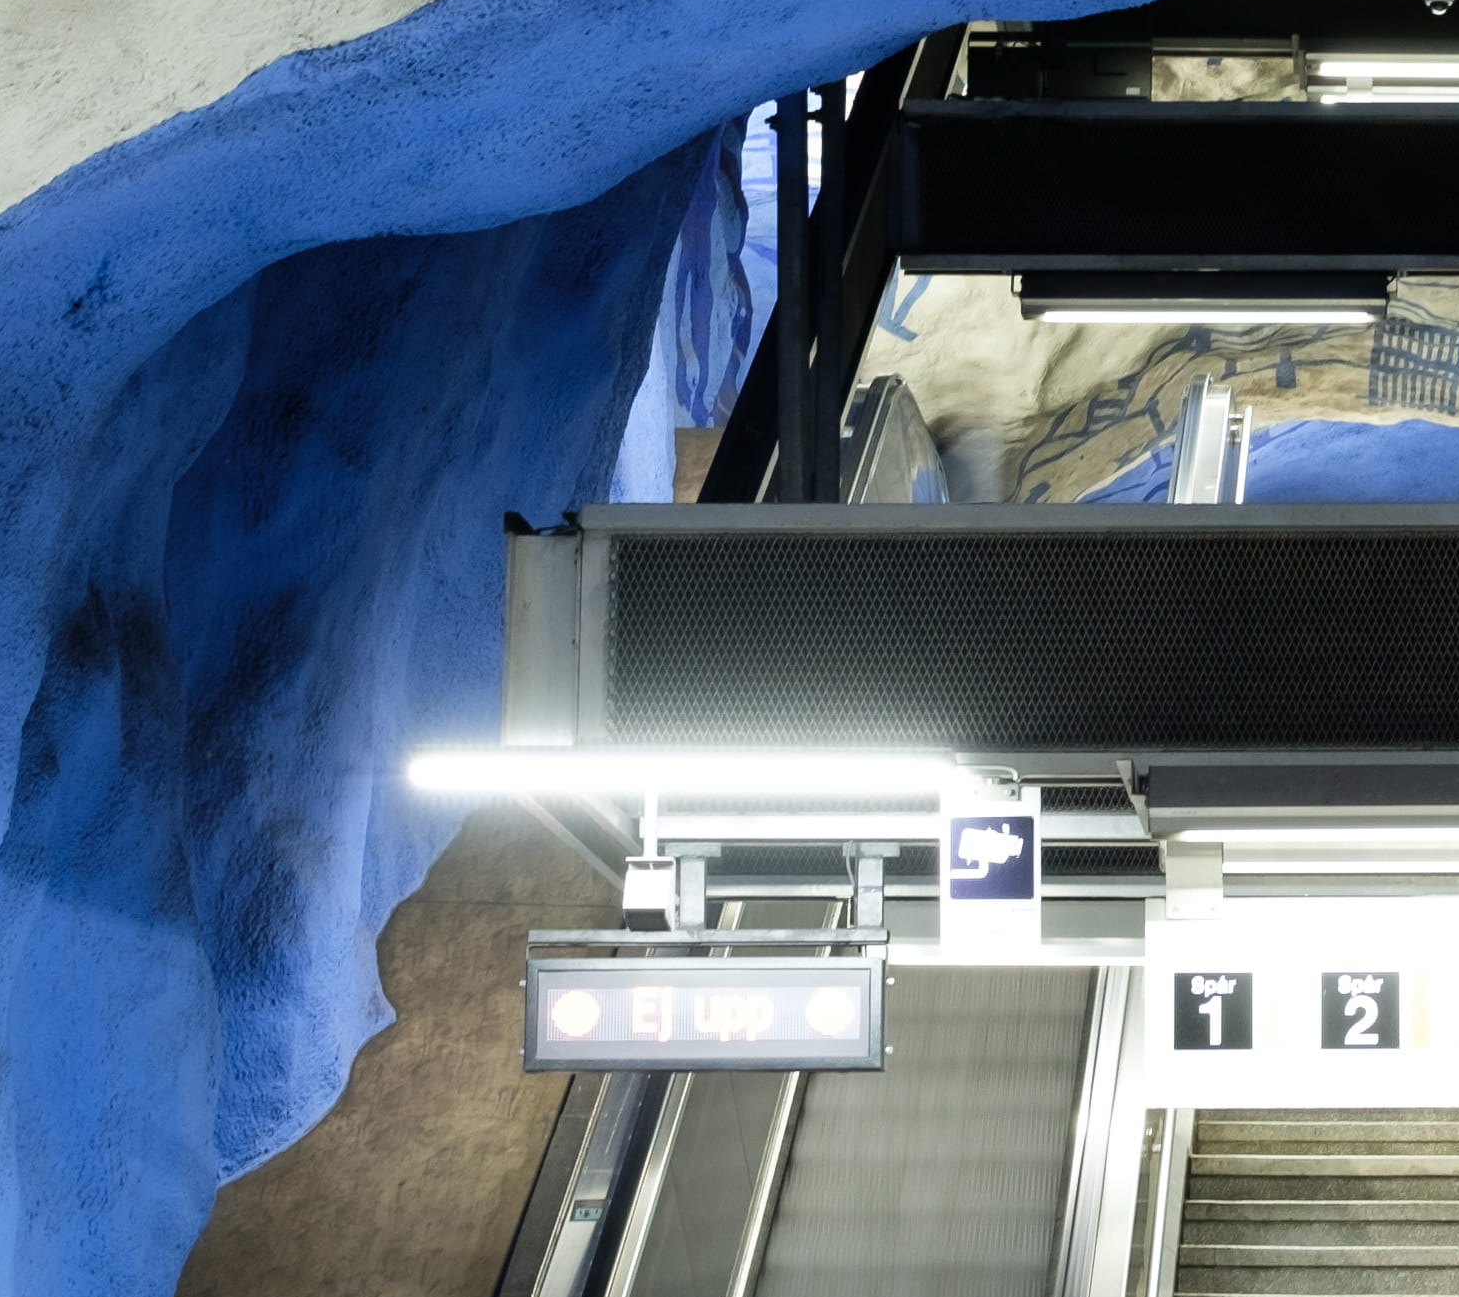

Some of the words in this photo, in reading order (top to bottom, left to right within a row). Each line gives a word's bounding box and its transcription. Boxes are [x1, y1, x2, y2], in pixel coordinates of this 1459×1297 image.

[1190, 975, 1237, 998] Spår
[1337, 974, 1384, 997] Spår
[631, 986, 674, 1043] Ej
[693, 993, 774, 1043] upp
[1198, 995, 1223, 1046] 1
[1344, 994, 1379, 1045] 2
